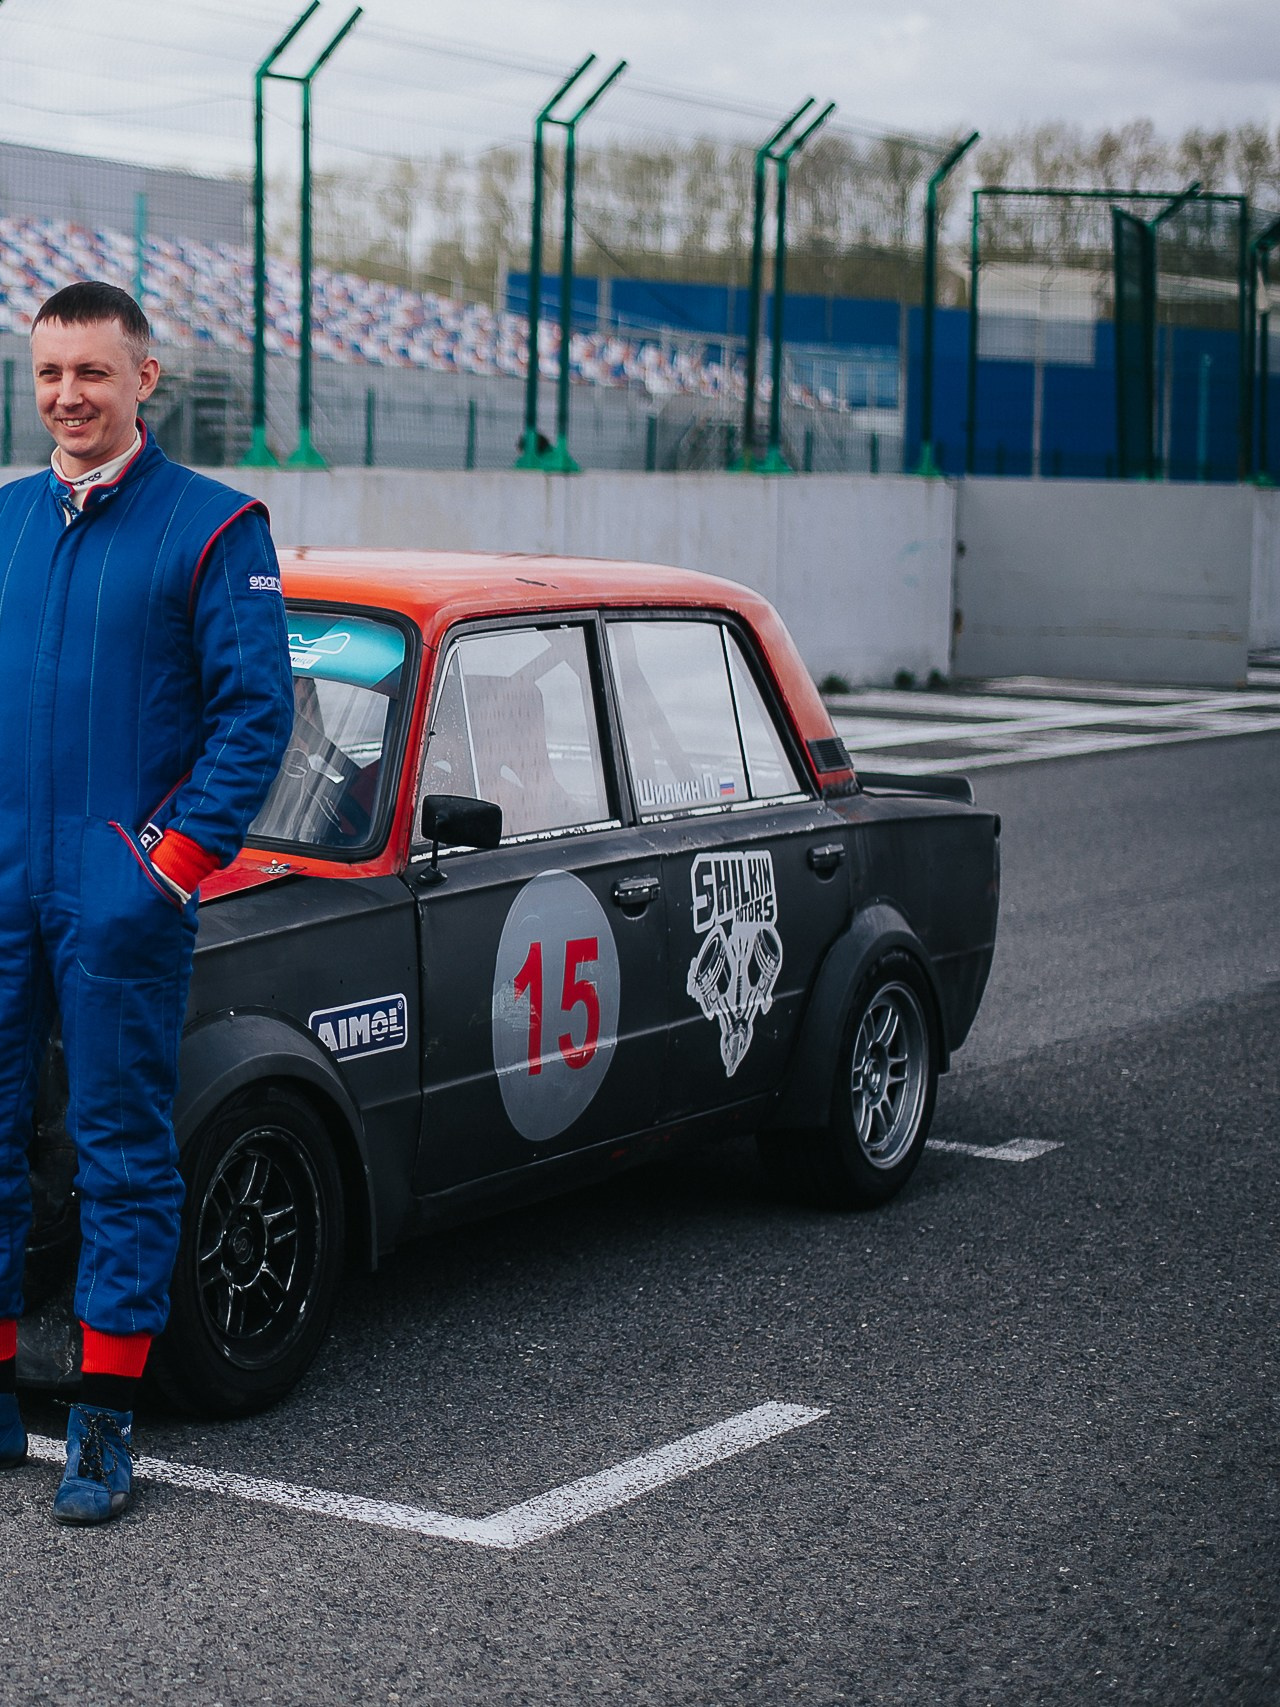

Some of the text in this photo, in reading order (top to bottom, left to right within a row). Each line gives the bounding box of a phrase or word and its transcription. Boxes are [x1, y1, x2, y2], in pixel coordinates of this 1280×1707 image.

[638, 778, 700, 806] Шилкин
[694, 856, 772, 926] SHILKIN
[735, 897, 774, 923] MOTORS
[514, 937, 599, 1076] 15
[318, 1008, 404, 1052] AIMOL
